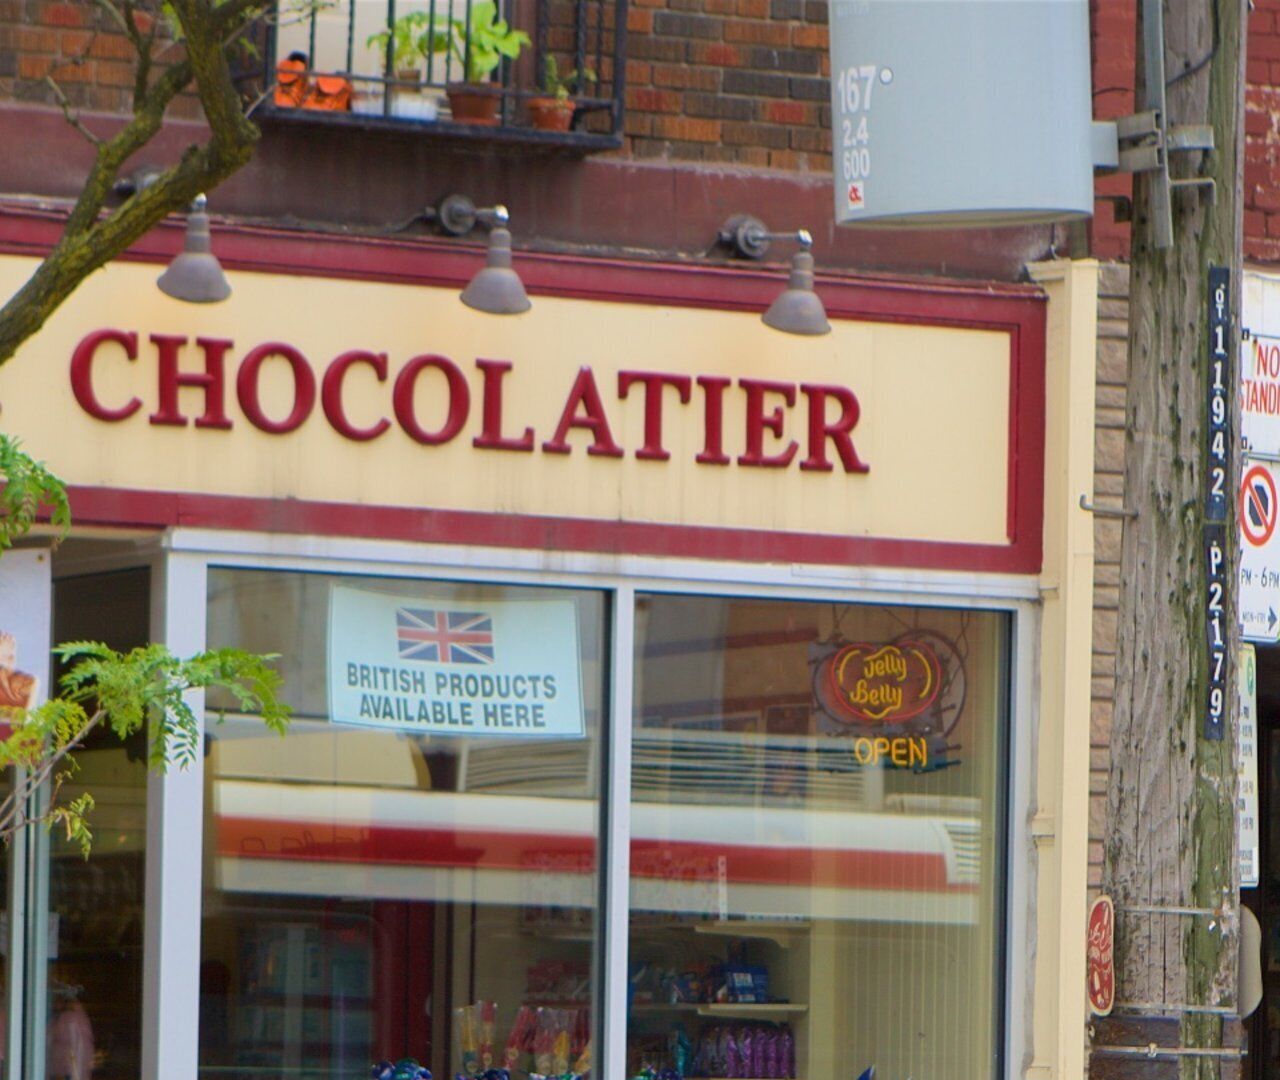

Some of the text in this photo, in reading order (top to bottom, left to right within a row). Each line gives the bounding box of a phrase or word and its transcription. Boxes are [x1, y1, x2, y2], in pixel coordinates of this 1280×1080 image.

[838, 65, 877, 114] 167
[843, 117, 869, 147] 2.4
[843, 149, 870, 181] 600
[1256, 345, 1280, 379] NO
[70, 328, 870, 474] CHOCOLATIER
[347, 662, 558, 700] BRITISH PRODUCTS
[863, 650, 908, 682] Jelly
[360, 693, 546, 728] AVAILABLE HERE
[849, 678, 903, 711] Belly
[854, 736, 928, 768] OPEN
